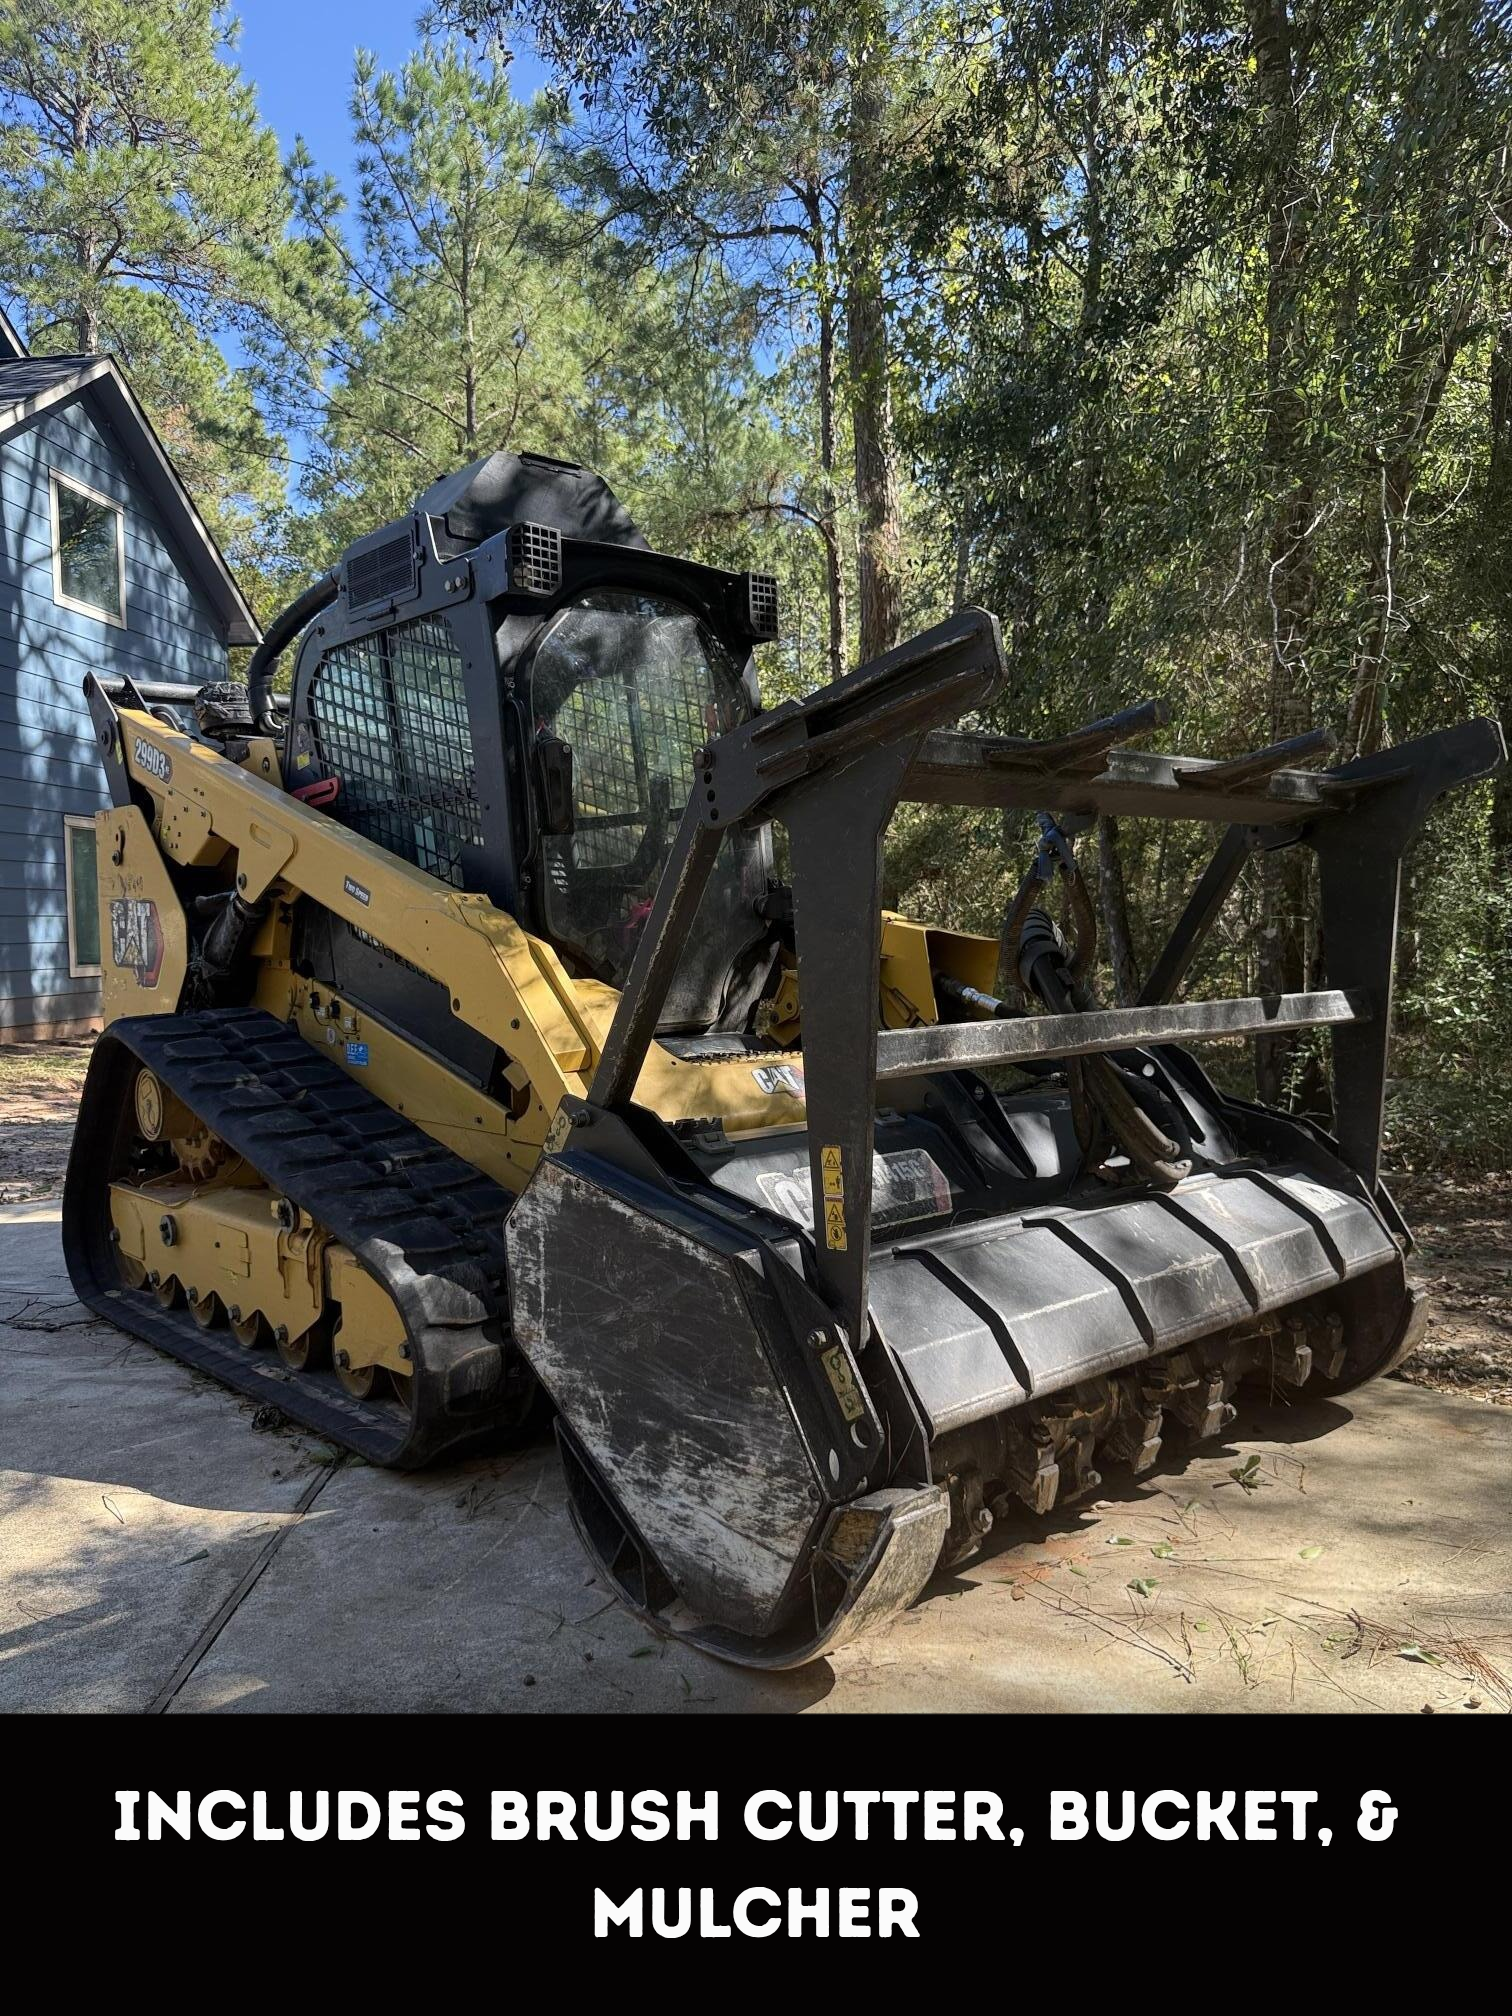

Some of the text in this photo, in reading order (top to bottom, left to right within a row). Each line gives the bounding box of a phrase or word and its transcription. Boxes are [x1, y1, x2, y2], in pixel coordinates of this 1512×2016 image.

[135, 737, 166, 779] 299D3
[112, 900, 151, 966] CAT
[751, 1065, 800, 1094] CAT
